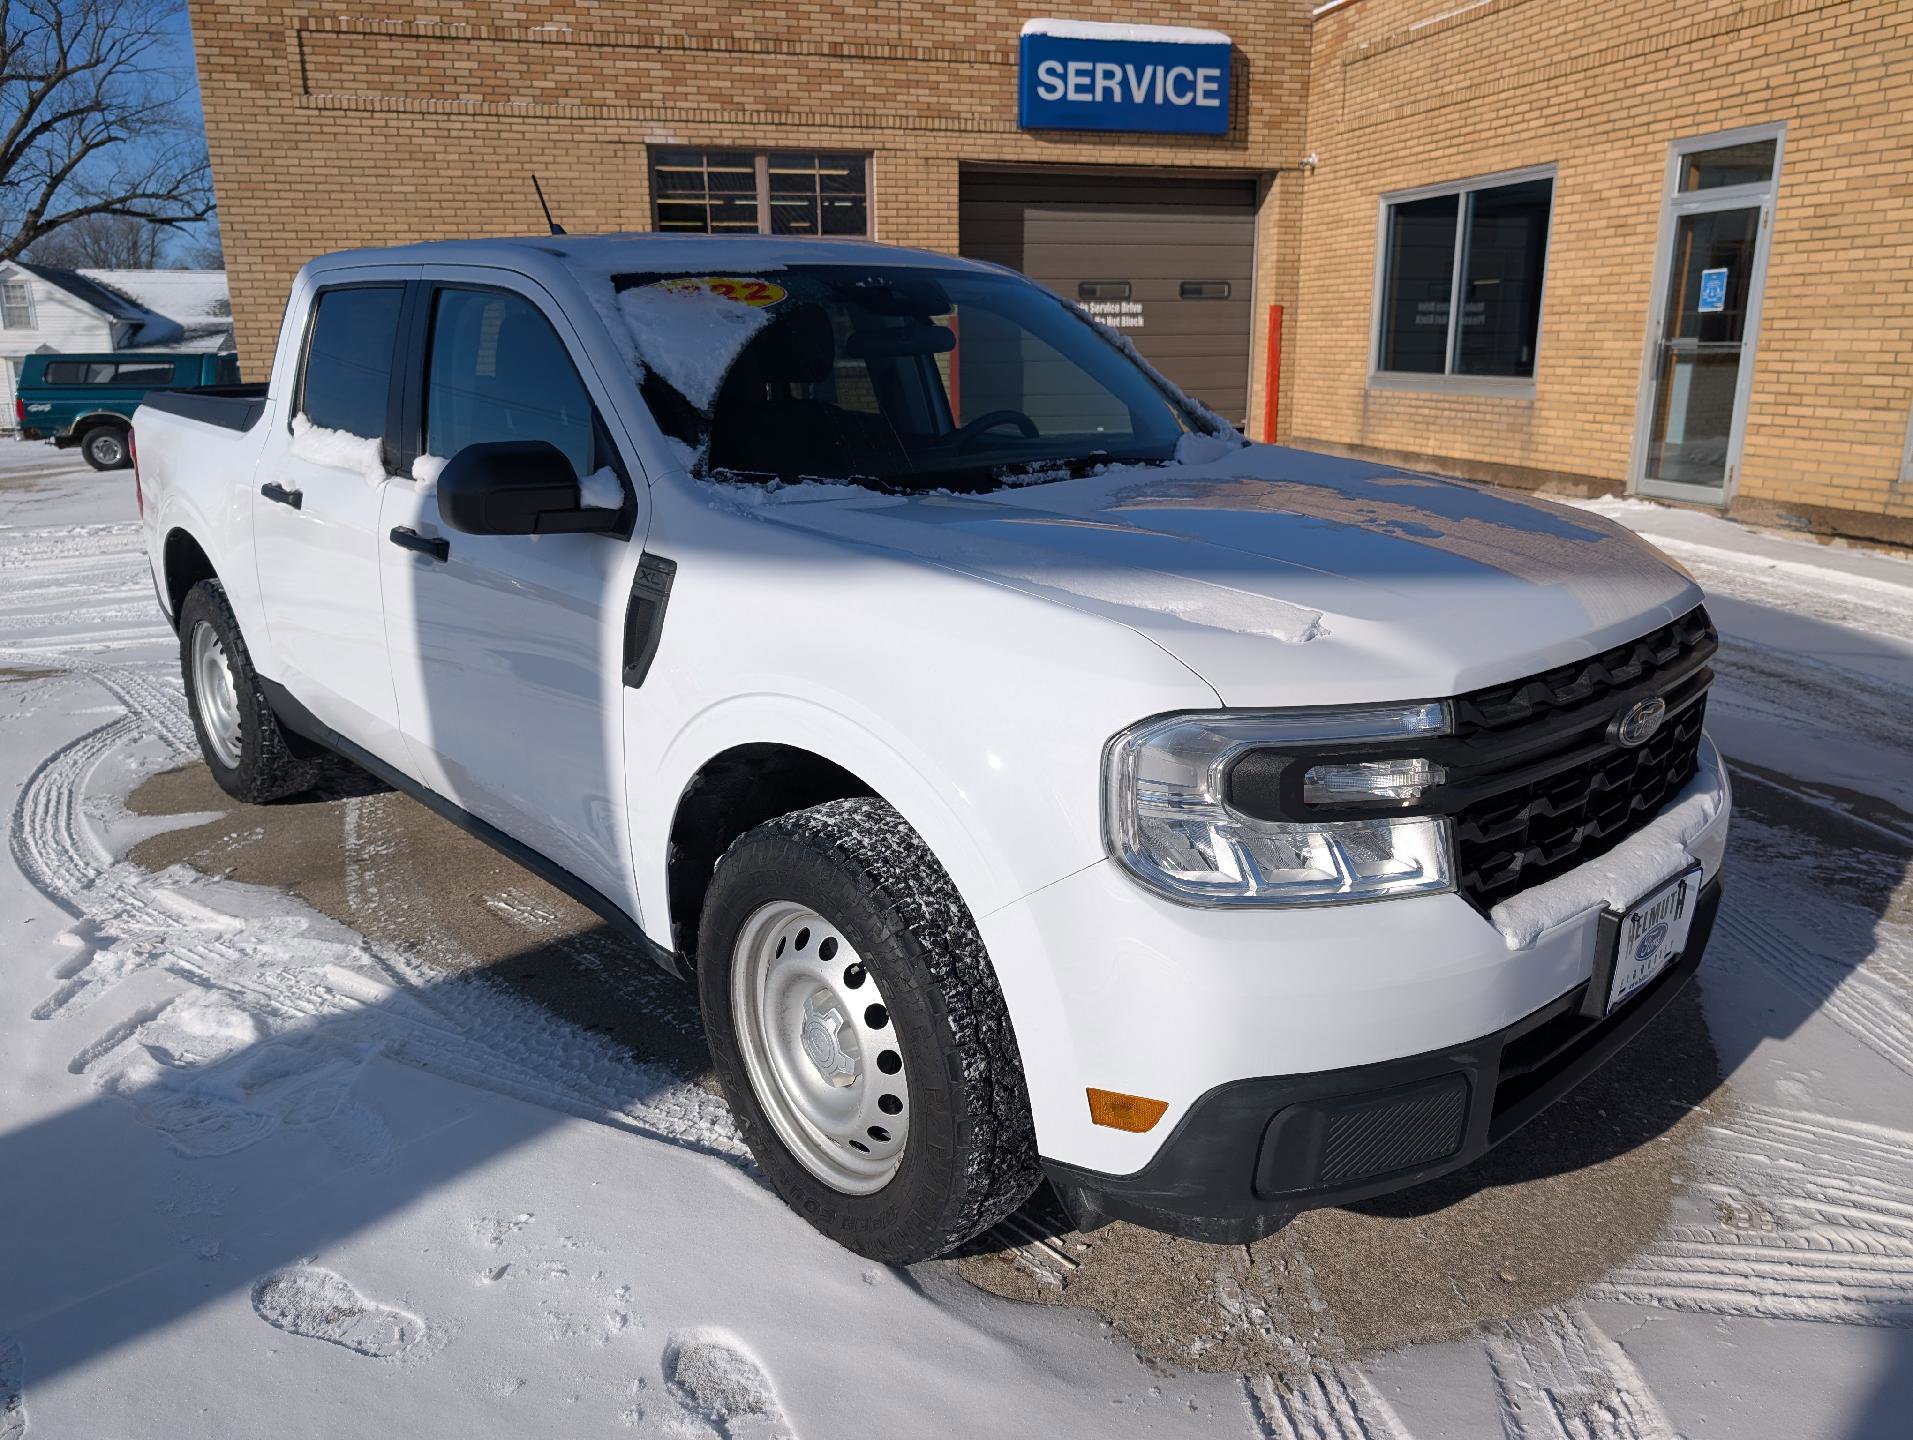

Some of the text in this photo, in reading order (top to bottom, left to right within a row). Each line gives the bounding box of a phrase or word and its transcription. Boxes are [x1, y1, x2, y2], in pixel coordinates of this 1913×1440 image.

[1037, 60, 1220, 107] SERVICE
[1090, 302, 1120, 314] Service
[1121, 302, 1143, 314] Drive
[1121, 316, 1144, 327] Block
[640, 569, 661, 585] XL
